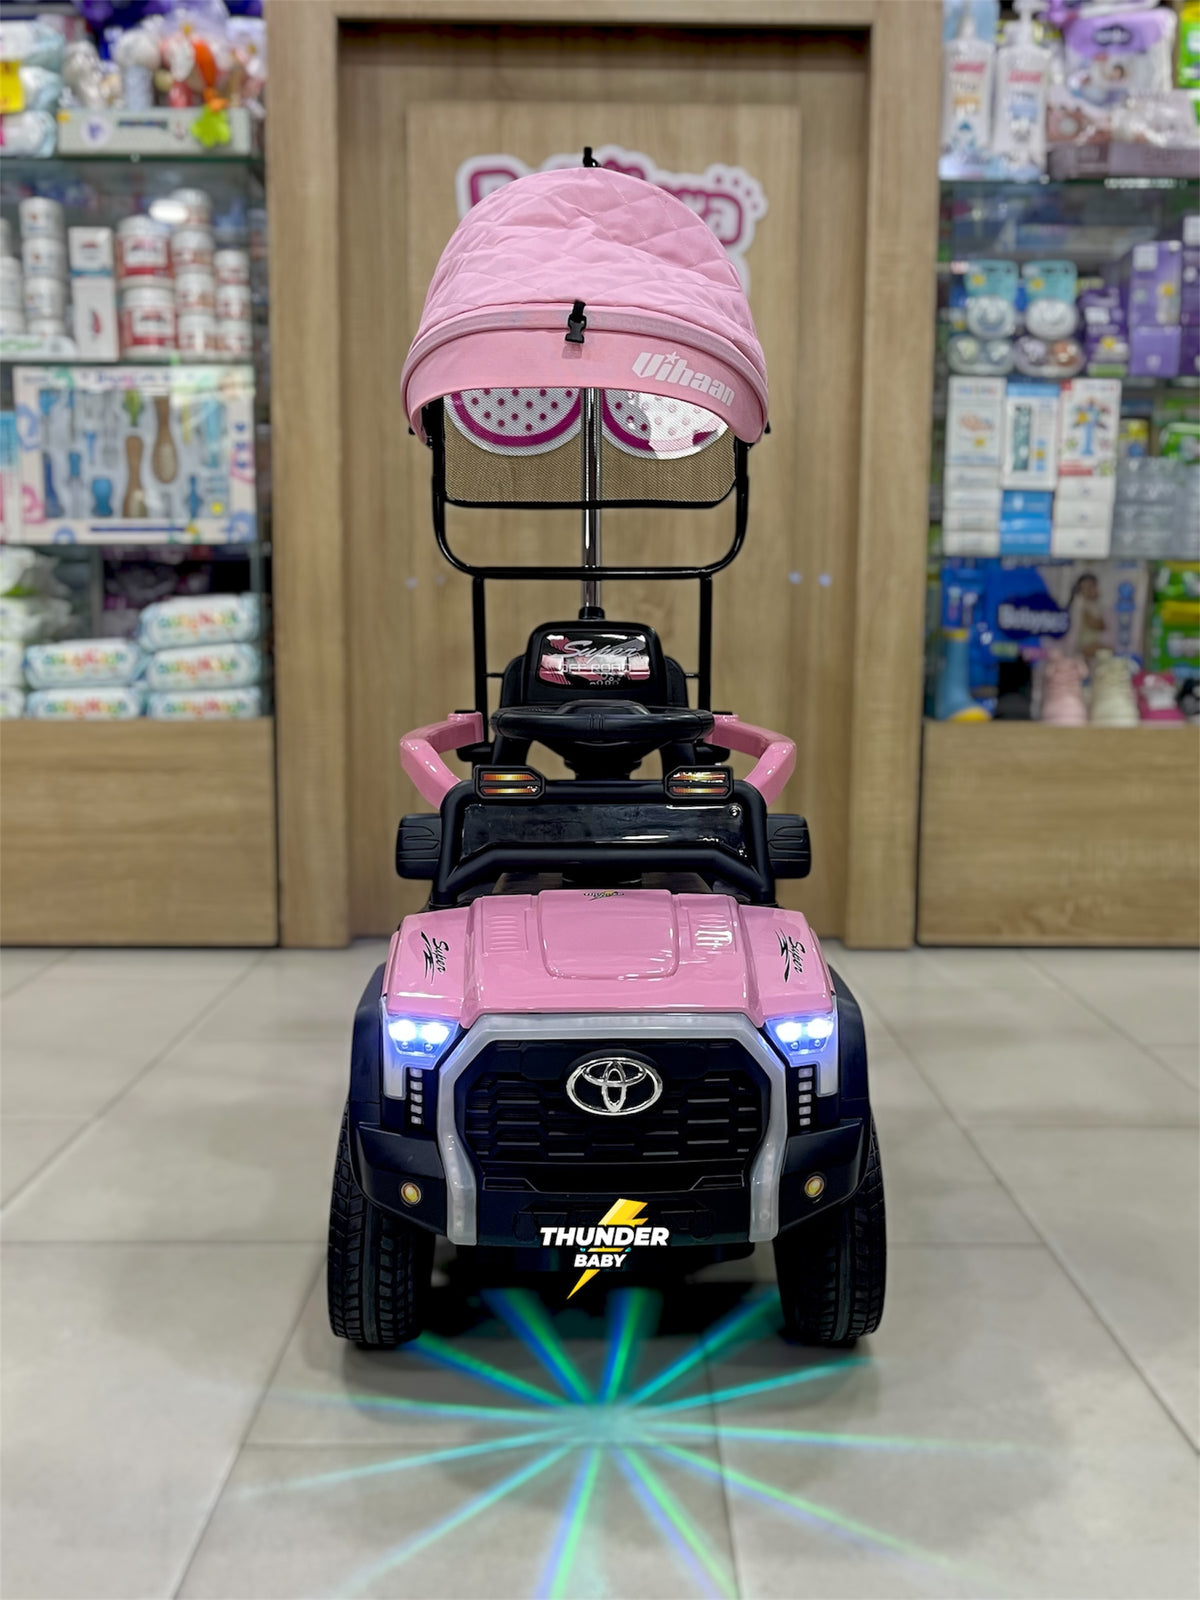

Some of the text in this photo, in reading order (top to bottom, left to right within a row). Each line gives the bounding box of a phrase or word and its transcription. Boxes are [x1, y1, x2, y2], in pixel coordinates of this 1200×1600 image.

[632, 352, 735, 407] Vihaan
[553, 640, 637, 664] Super
[558, 663, 584, 673] OFF
[432, 937, 450, 973] Super
[787, 935, 806, 973] Super
